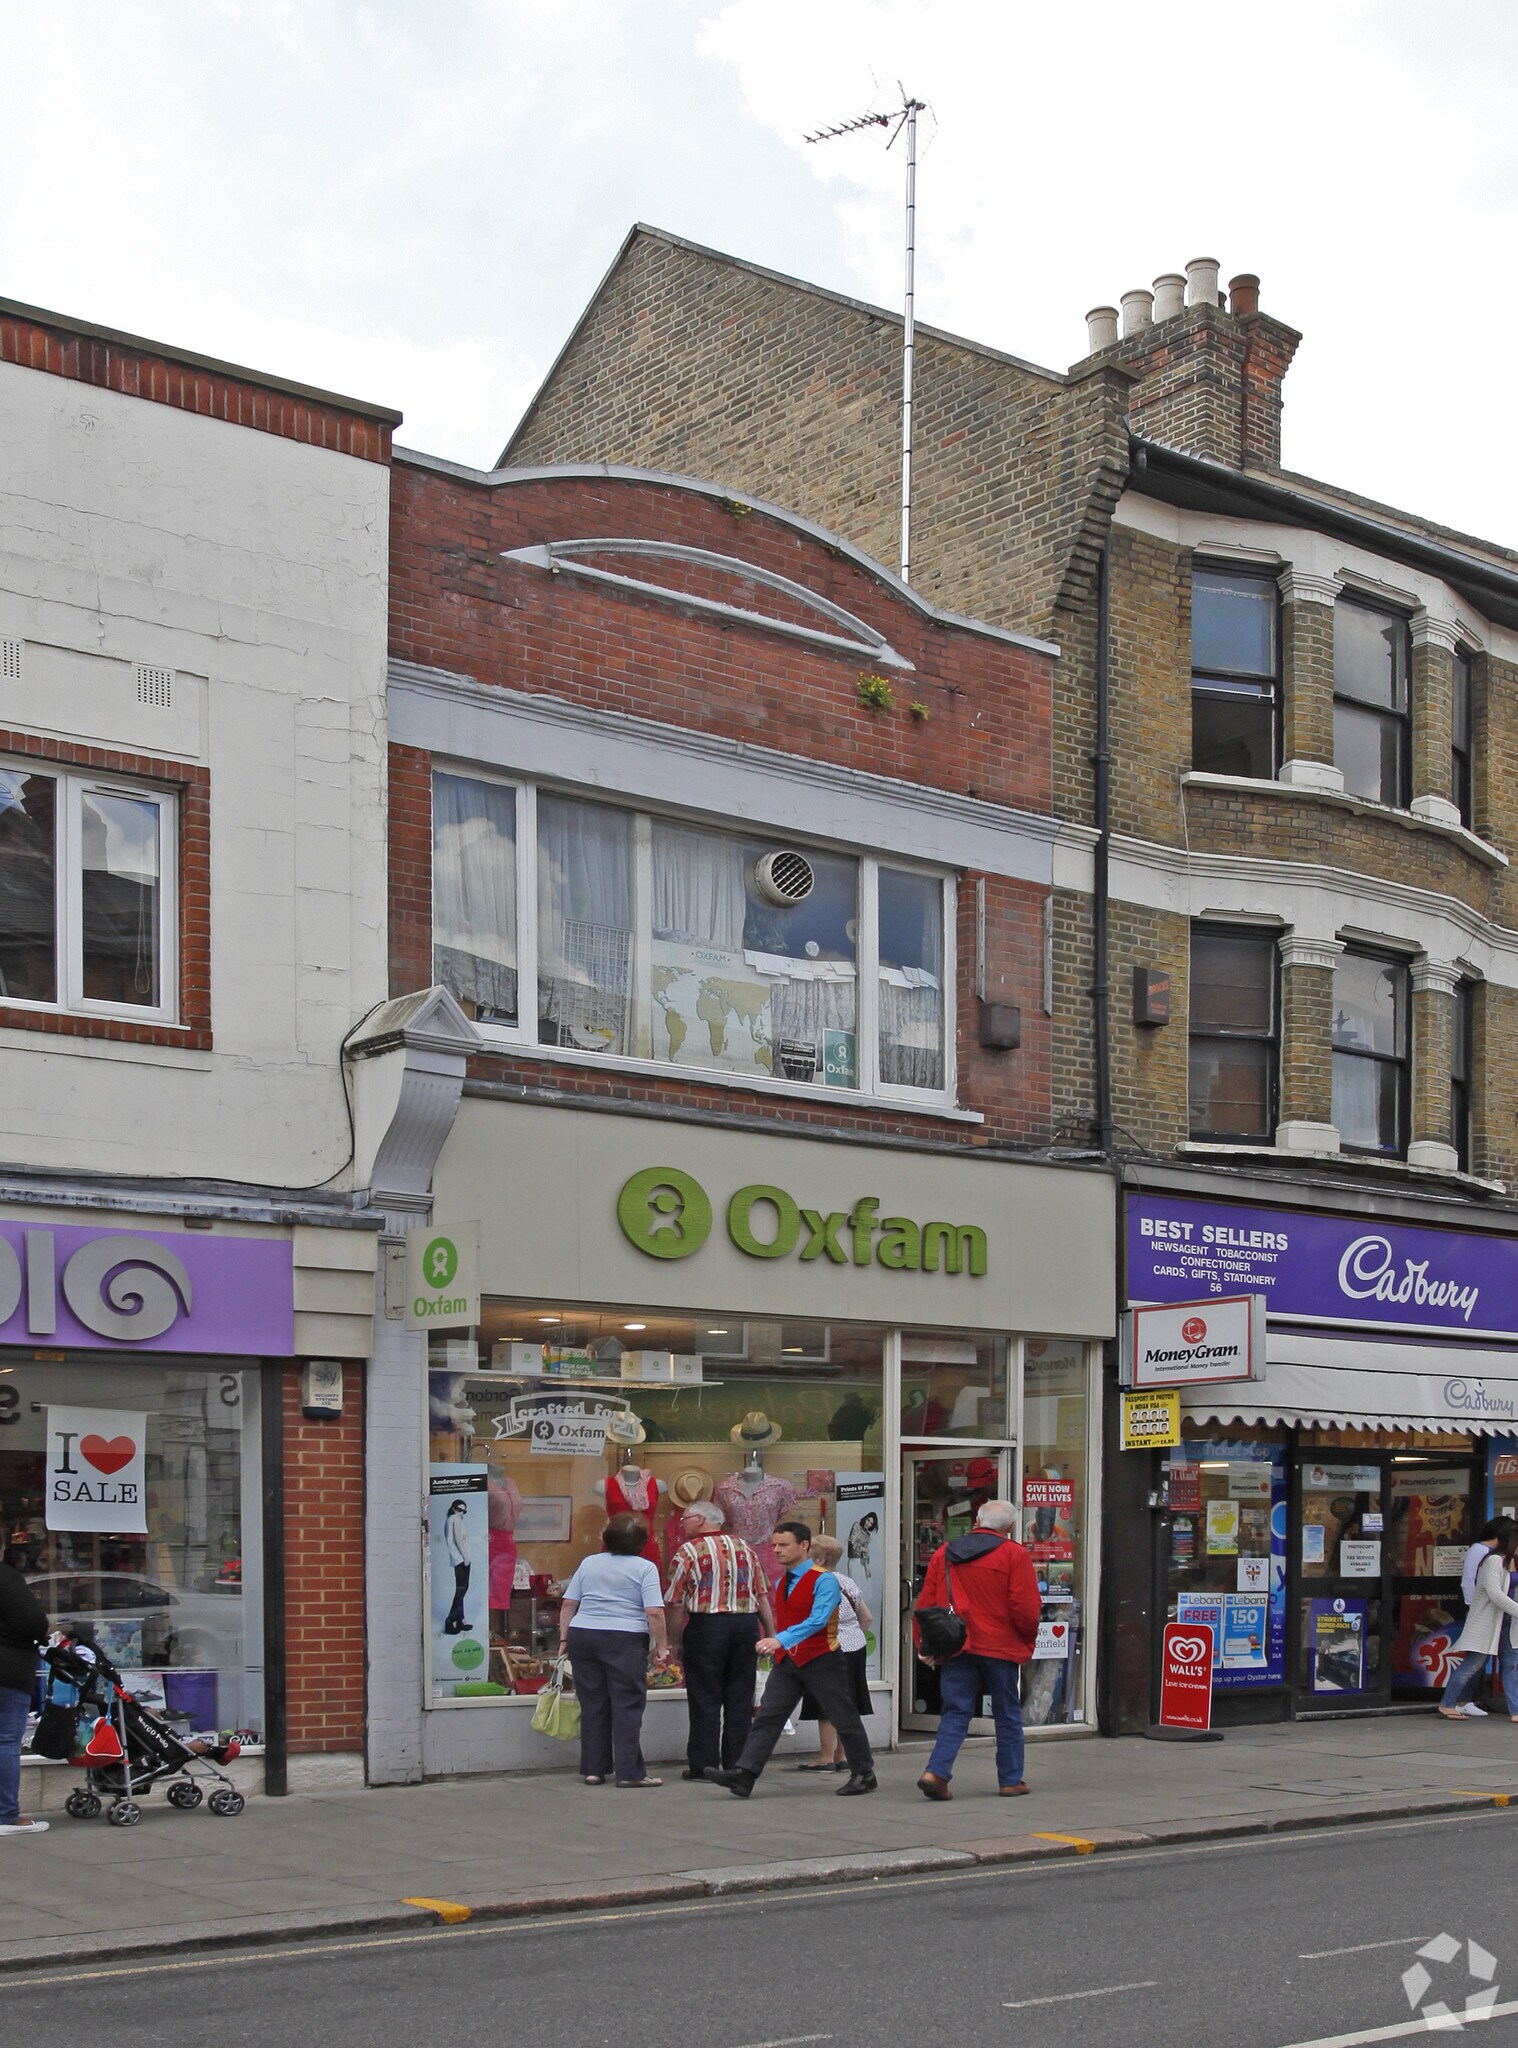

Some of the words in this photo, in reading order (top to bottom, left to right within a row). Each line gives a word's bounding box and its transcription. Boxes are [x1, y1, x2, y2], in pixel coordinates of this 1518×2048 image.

[695, 950, 727, 963] OXFAM
[726, 1184, 988, 1276] Oxfam
[1140, 1217, 1193, 1241] BEST
[1202, 1224, 1289, 1251] SELLERS
[1151, 1240, 1209, 1256] NEWSAGENT
[1215, 1247, 1278, 1262] TOBACCONIST
[1180, 1256, 1251, 1271] CONFECTIONER
[1153, 1265, 1188, 1279] CARDS,
[1191, 1269, 1220, 1282] GIFTS,
[1223, 1272, 1277, 1285] STATIONERY
[1338, 1235, 1479, 1322] Cadbury
[1210, 1282, 1222, 1292] 56
[413, 1295, 467, 1318] Oxfam
[1144, 1344, 1238, 1364] MoneyGram
[1154, 1363, 1189, 1372] International
[1443, 1378, 1514, 1417] Cadbury
[518, 1401, 585, 1422] crafted
[558, 1424, 605, 1439] Oxfam
[54, 1431, 79, 1475] I
[1026, 1484, 1047, 1493] GIVE
[1048, 1484, 1070, 1493] NOW
[1400, 1477, 1456, 1486] MoneyGram
[53, 1480, 138, 1504] SALE
[1026, 1493, 1047, 1502] SAVE
[1049, 1493, 1072, 1502] LIVES
[1428, 1515, 1452, 1531] egg
[1188, 1595, 1222, 1605] Lebara
[1234, 1595, 1267, 1605] Lebara
[1184, 1610, 1218, 1621] FREE
[1231, 1608, 1259, 1625] 150
[1035, 1640, 1066, 1648] Enfield
[1169, 1664, 1203, 1676] WALL'S
[1247, 1673, 1267, 1681] Oyster
